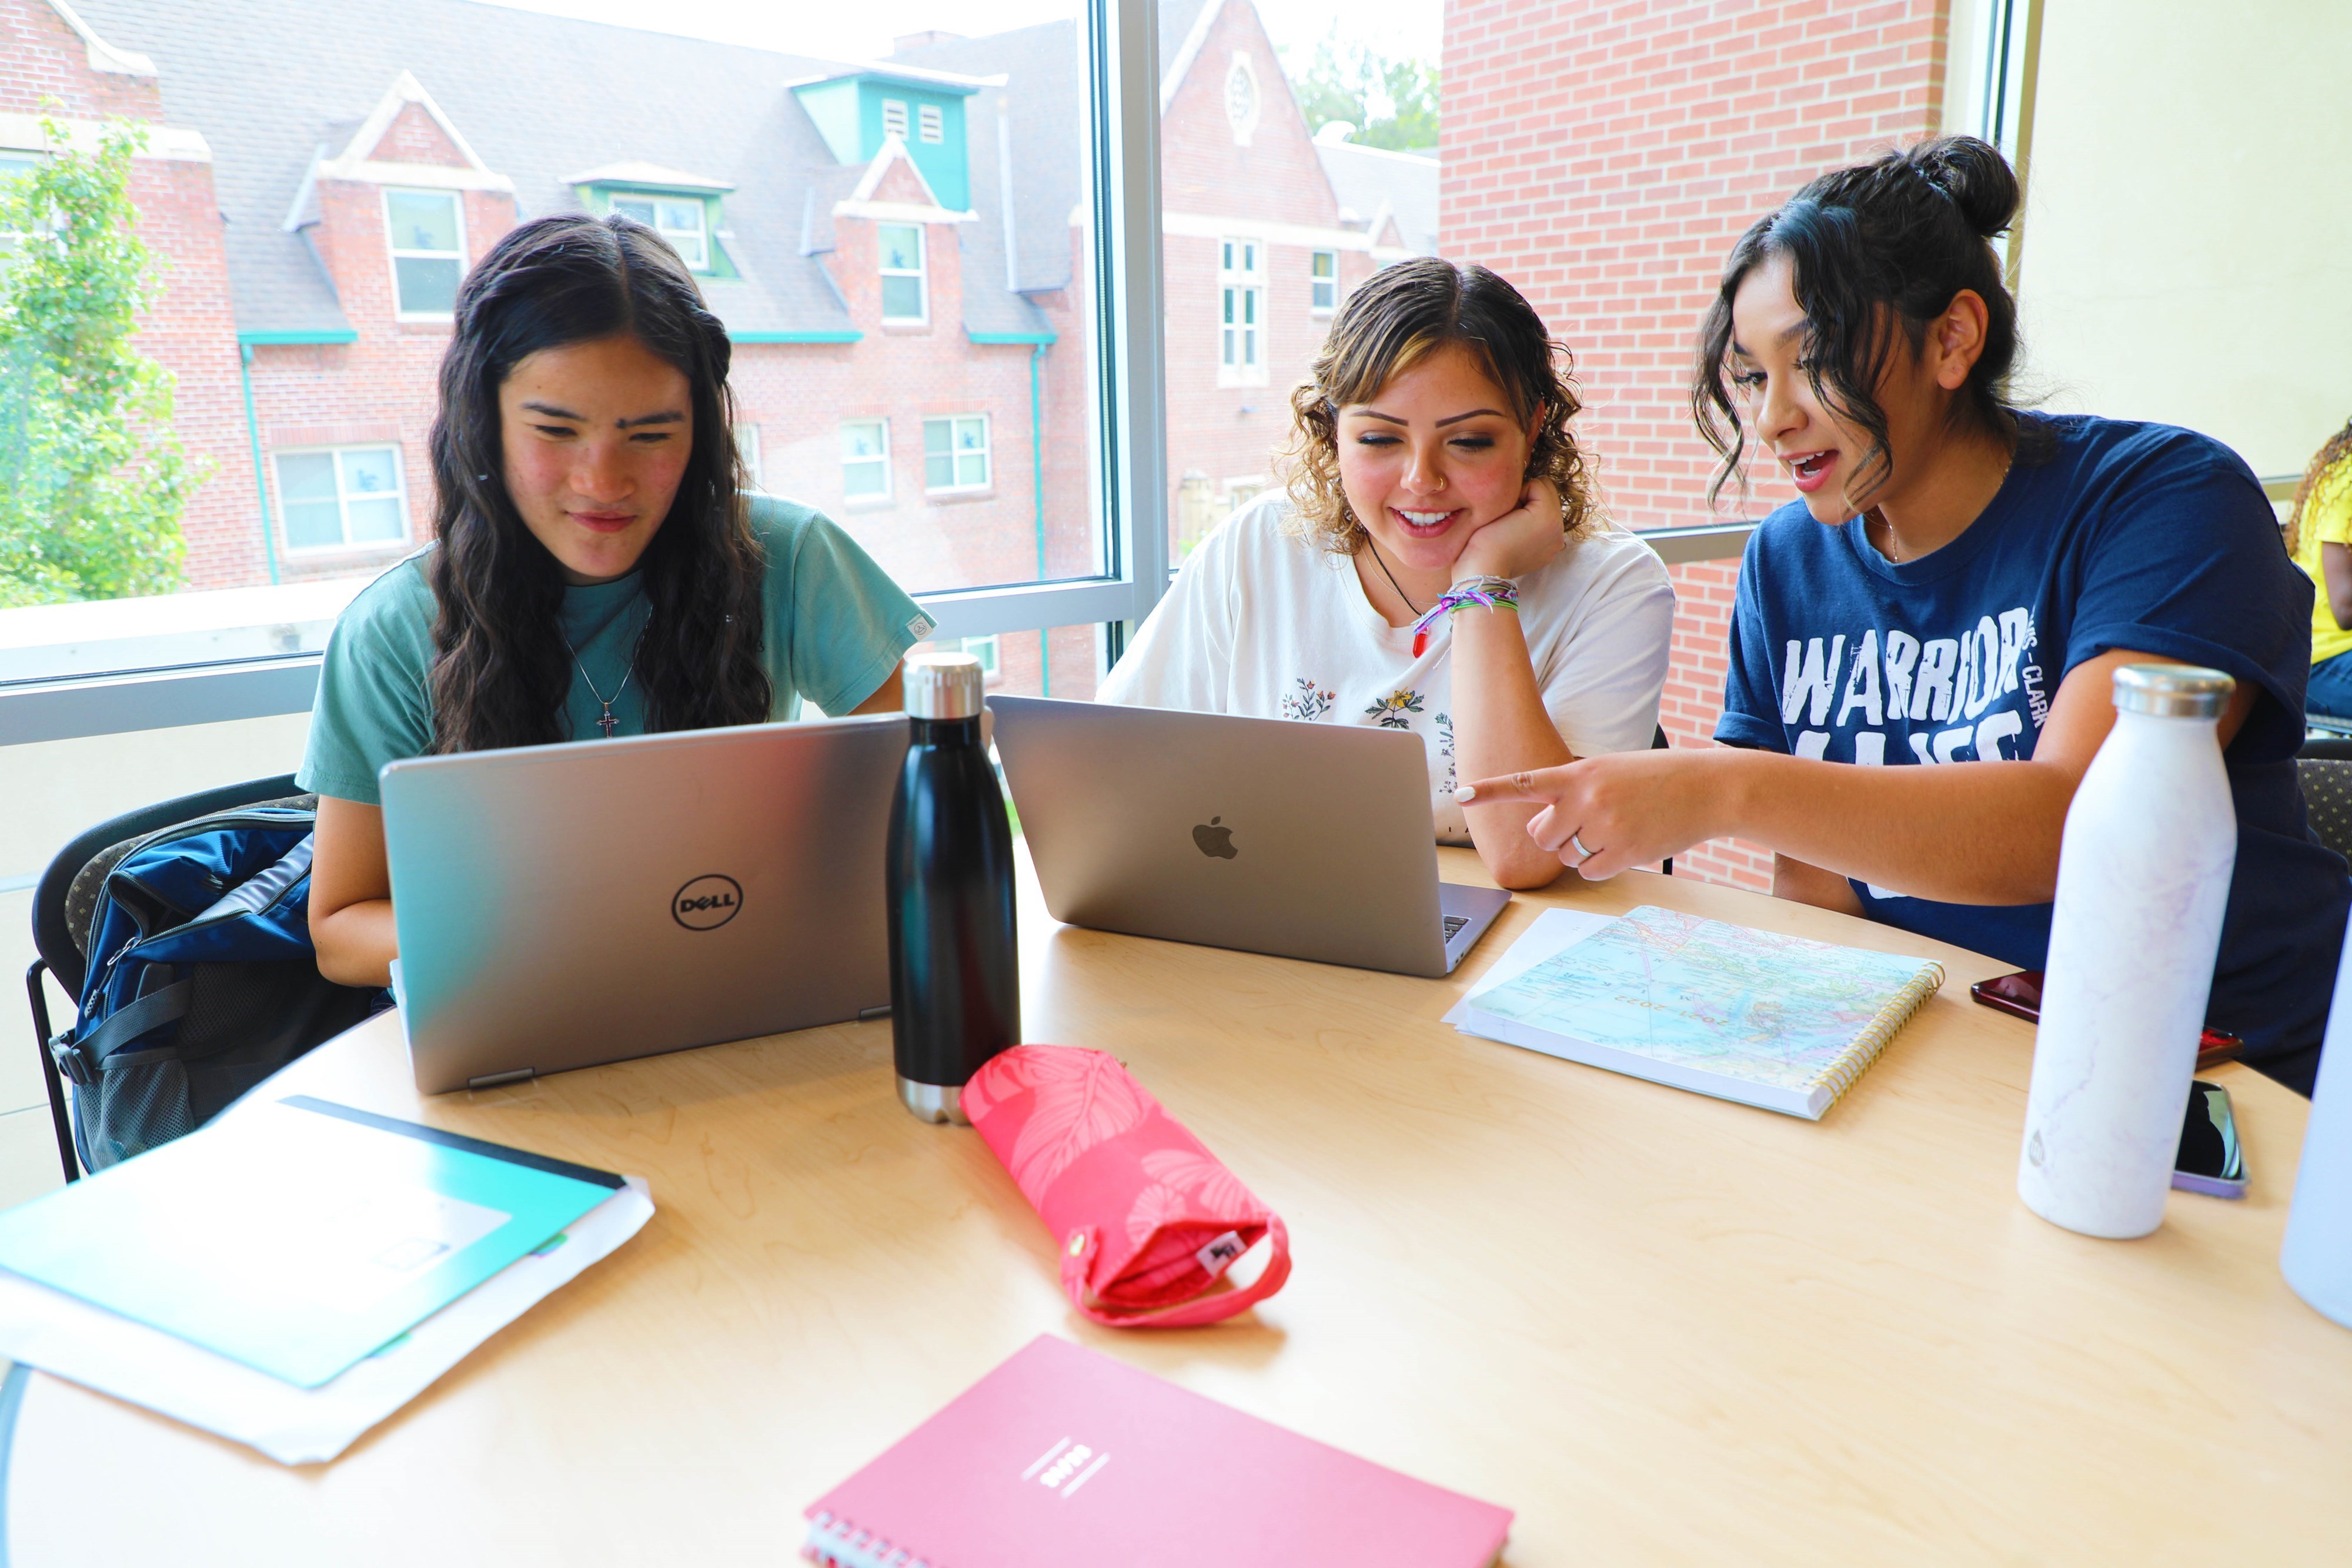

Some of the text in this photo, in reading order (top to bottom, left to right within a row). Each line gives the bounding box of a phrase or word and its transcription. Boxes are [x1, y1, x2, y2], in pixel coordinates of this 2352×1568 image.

[1782, 606, 2029, 727] WARRIOR
[680, 893, 735, 913] DELL
[1614, 994, 1729, 1027] 2021-2022
